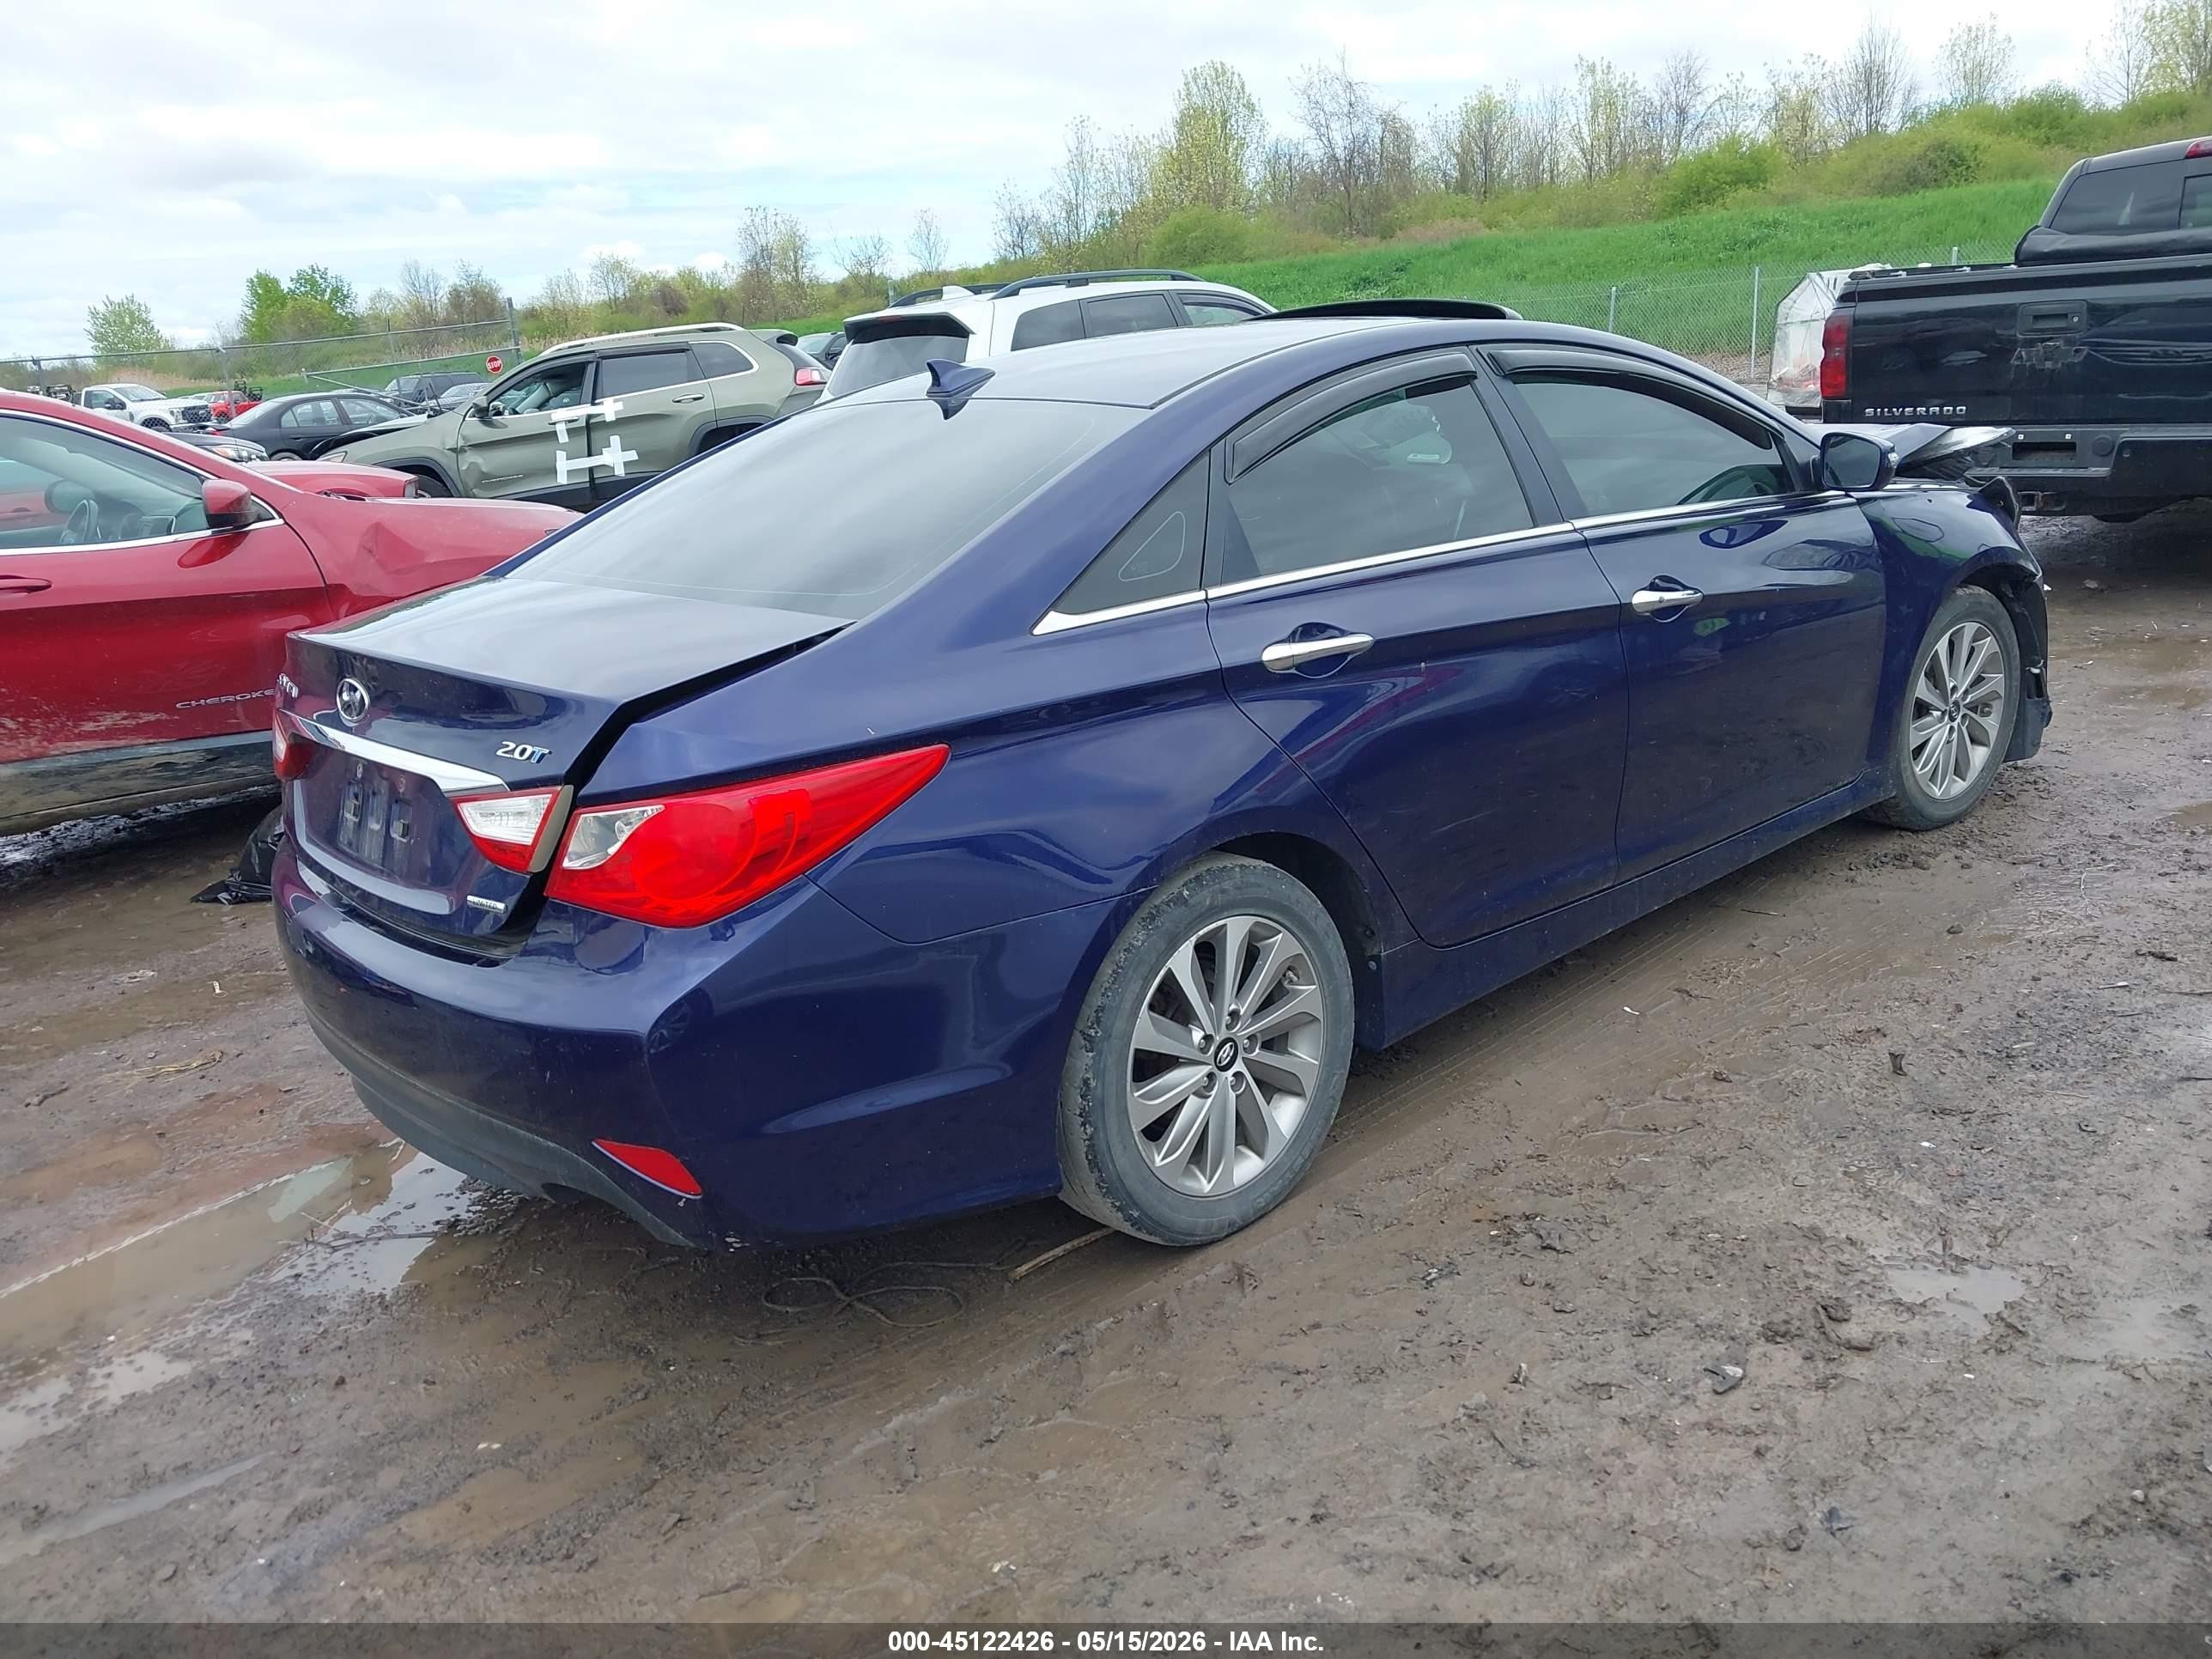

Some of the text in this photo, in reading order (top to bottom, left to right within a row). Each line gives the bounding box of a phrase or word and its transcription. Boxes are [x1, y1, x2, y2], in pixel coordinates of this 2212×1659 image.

[487, 360, 502, 369] STOP
[1864, 406, 1966, 416] SILVERADO
[175, 688, 275, 709] CHEROKE
